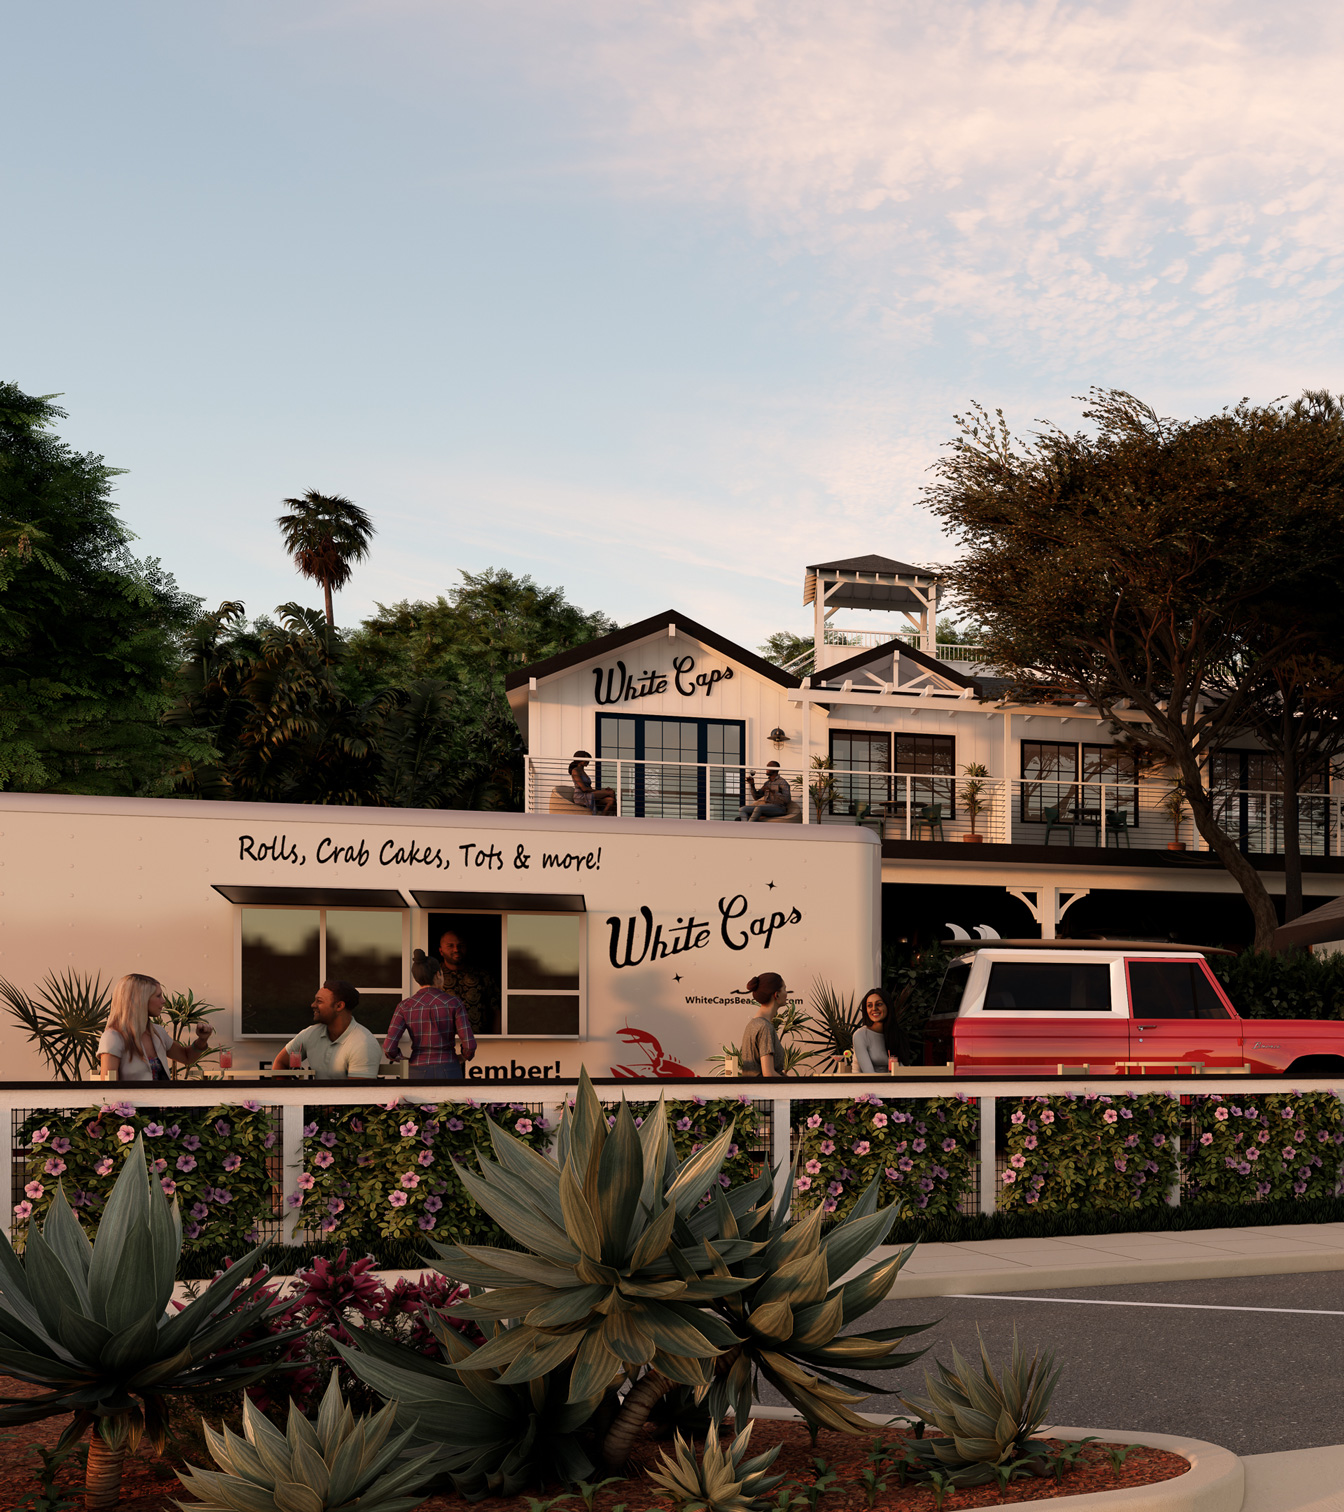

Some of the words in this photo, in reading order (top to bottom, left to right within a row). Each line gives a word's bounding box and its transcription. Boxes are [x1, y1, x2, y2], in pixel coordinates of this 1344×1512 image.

[592, 661, 667, 705] White
[673, 656, 734, 696] Caps
[238, 835, 306, 866] Rolls,
[316, 838, 370, 867] Crab
[379, 840, 450, 870] Cakes,
[459, 843, 504, 870] Tots
[513, 844, 531, 869] &
[542, 847, 602, 871] more!
[606, 905, 710, 969] White
[718, 894, 802, 951] Caps
